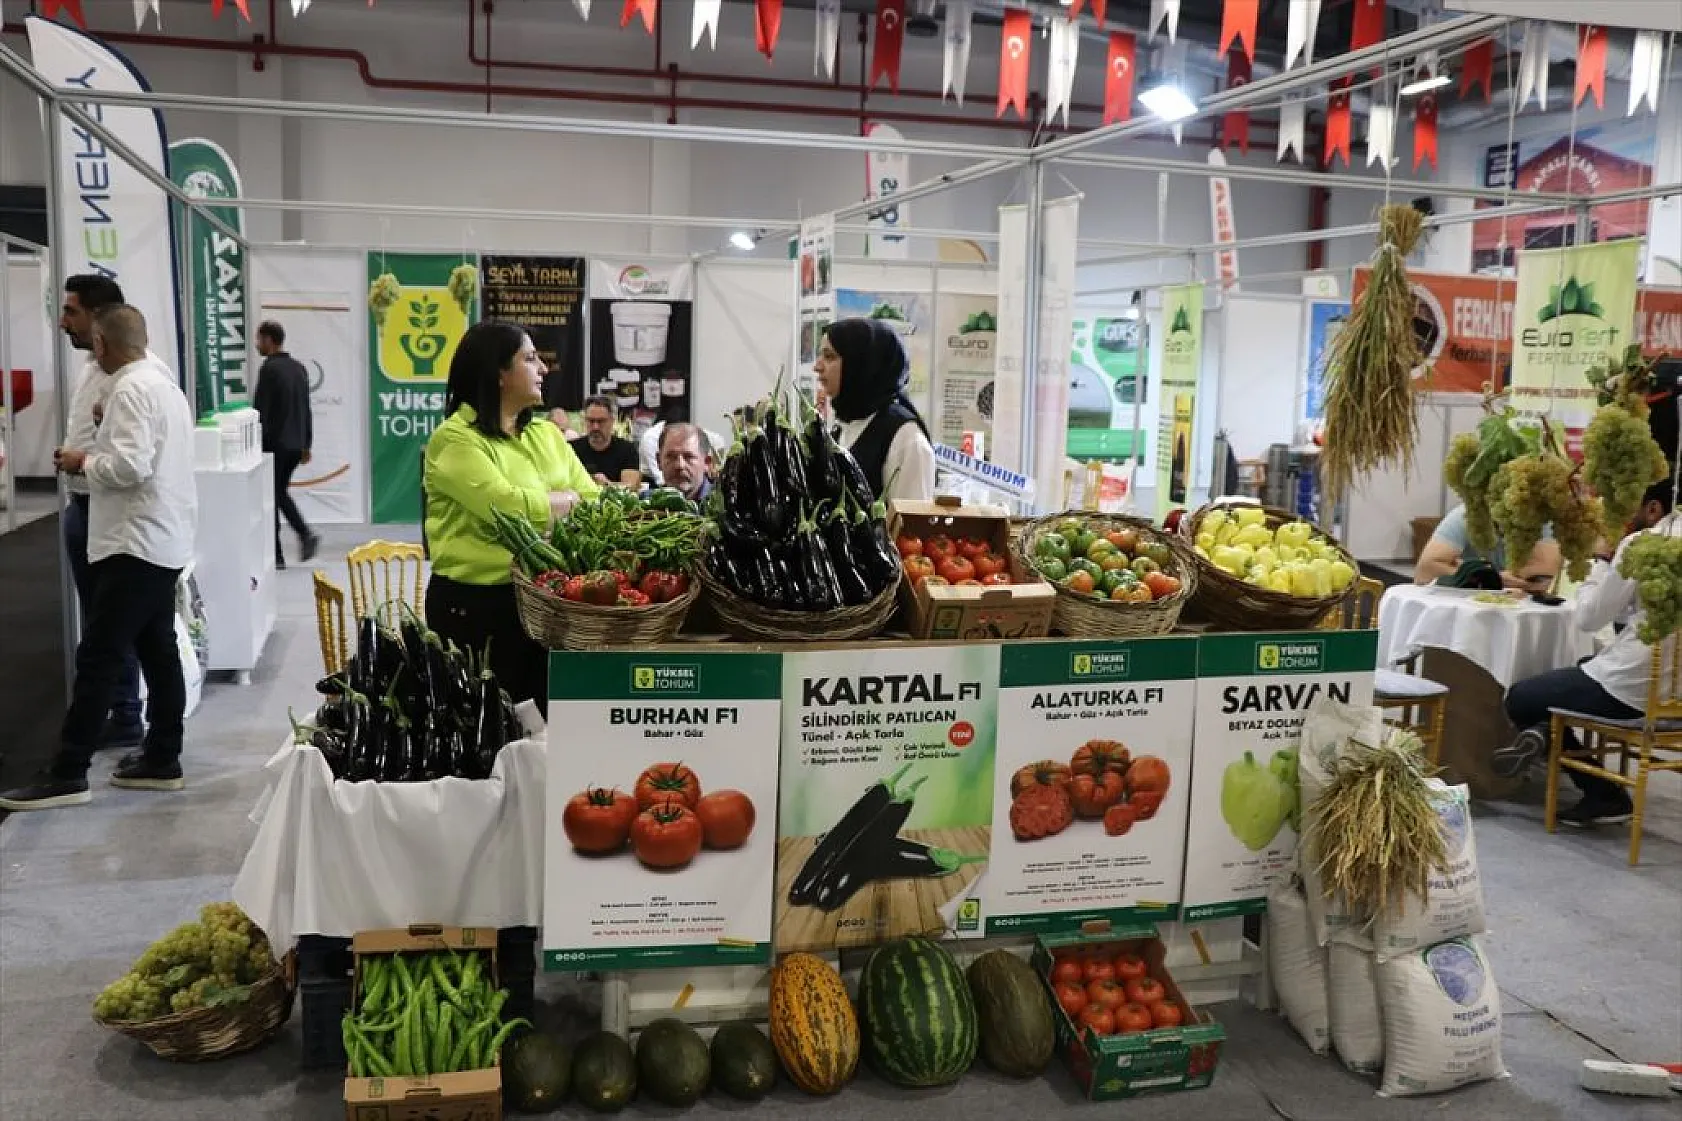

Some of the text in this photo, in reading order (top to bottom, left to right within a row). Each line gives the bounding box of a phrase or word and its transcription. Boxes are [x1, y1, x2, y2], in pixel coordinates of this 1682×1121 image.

[378, 388, 447, 411] YÜKS
[974, 459, 1026, 490] TOHUM
[1280, 656, 1319, 668] TOHUM
[655, 667, 696, 678] YÜKSEL
[655, 679, 694, 689] TOHUM
[802, 673, 982, 707] KARTAL F1
[1031, 687, 1164, 709] ALATURKA F1
[610, 707, 739, 725] BURHAN F1
[801, 709, 957, 728] SİLİNDİRİK PATLICAN
[1228, 719, 1263, 731] BEYAZ
[801, 731, 835, 743] Tünel
[874, 728, 905, 739] Tarla
